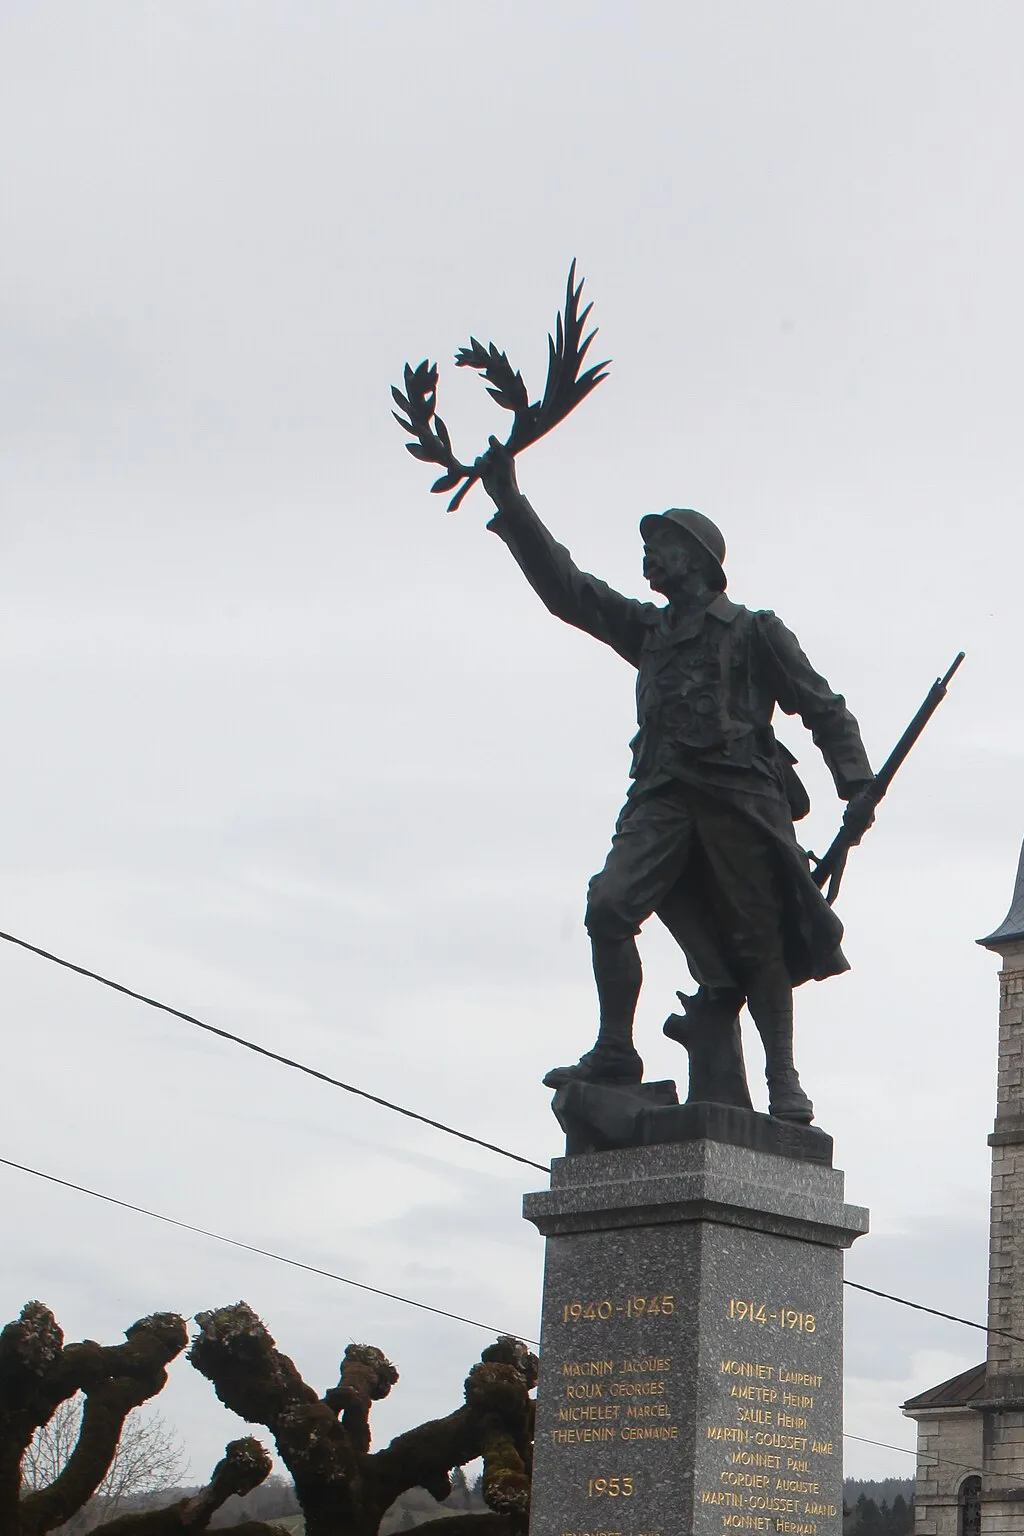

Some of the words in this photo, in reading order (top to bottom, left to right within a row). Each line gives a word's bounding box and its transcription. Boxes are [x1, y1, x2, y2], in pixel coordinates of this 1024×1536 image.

[561, 1295, 675, 1323] 1940-1945
[729, 1299, 816, 1333] 1914-1918
[562, 1359, 613, 1377] MAGNIN
[720, 1360, 773, 1379] MONNET
[778, 1367, 822, 1387] LAURENT
[566, 1384, 602, 1400] ROUX
[609, 1381, 665, 1397] GEORGES
[782, 1391, 814, 1408] HENRI
[559, 1405, 621, 1421] MICHELET
[626, 1404, 672, 1418] MARCEL
[737, 1407, 772, 1425] SAULE
[777, 1412, 807, 1429] HENRI
[551, 1427, 614, 1443] THEVENIN
[620, 1426, 678, 1440] GERMAINE
[731, 1451, 781, 1469] MONNET
[787, 1457, 810, 1473] PAUL
[587, 1476, 634, 1497] 1953
[720, 1471, 770, 1489] CORDIER
[776, 1478, 819, 1494] AUGUSTE
[722, 1515, 771, 1530] MONNET
[776, 1518, 817, 1534] HERMAN
